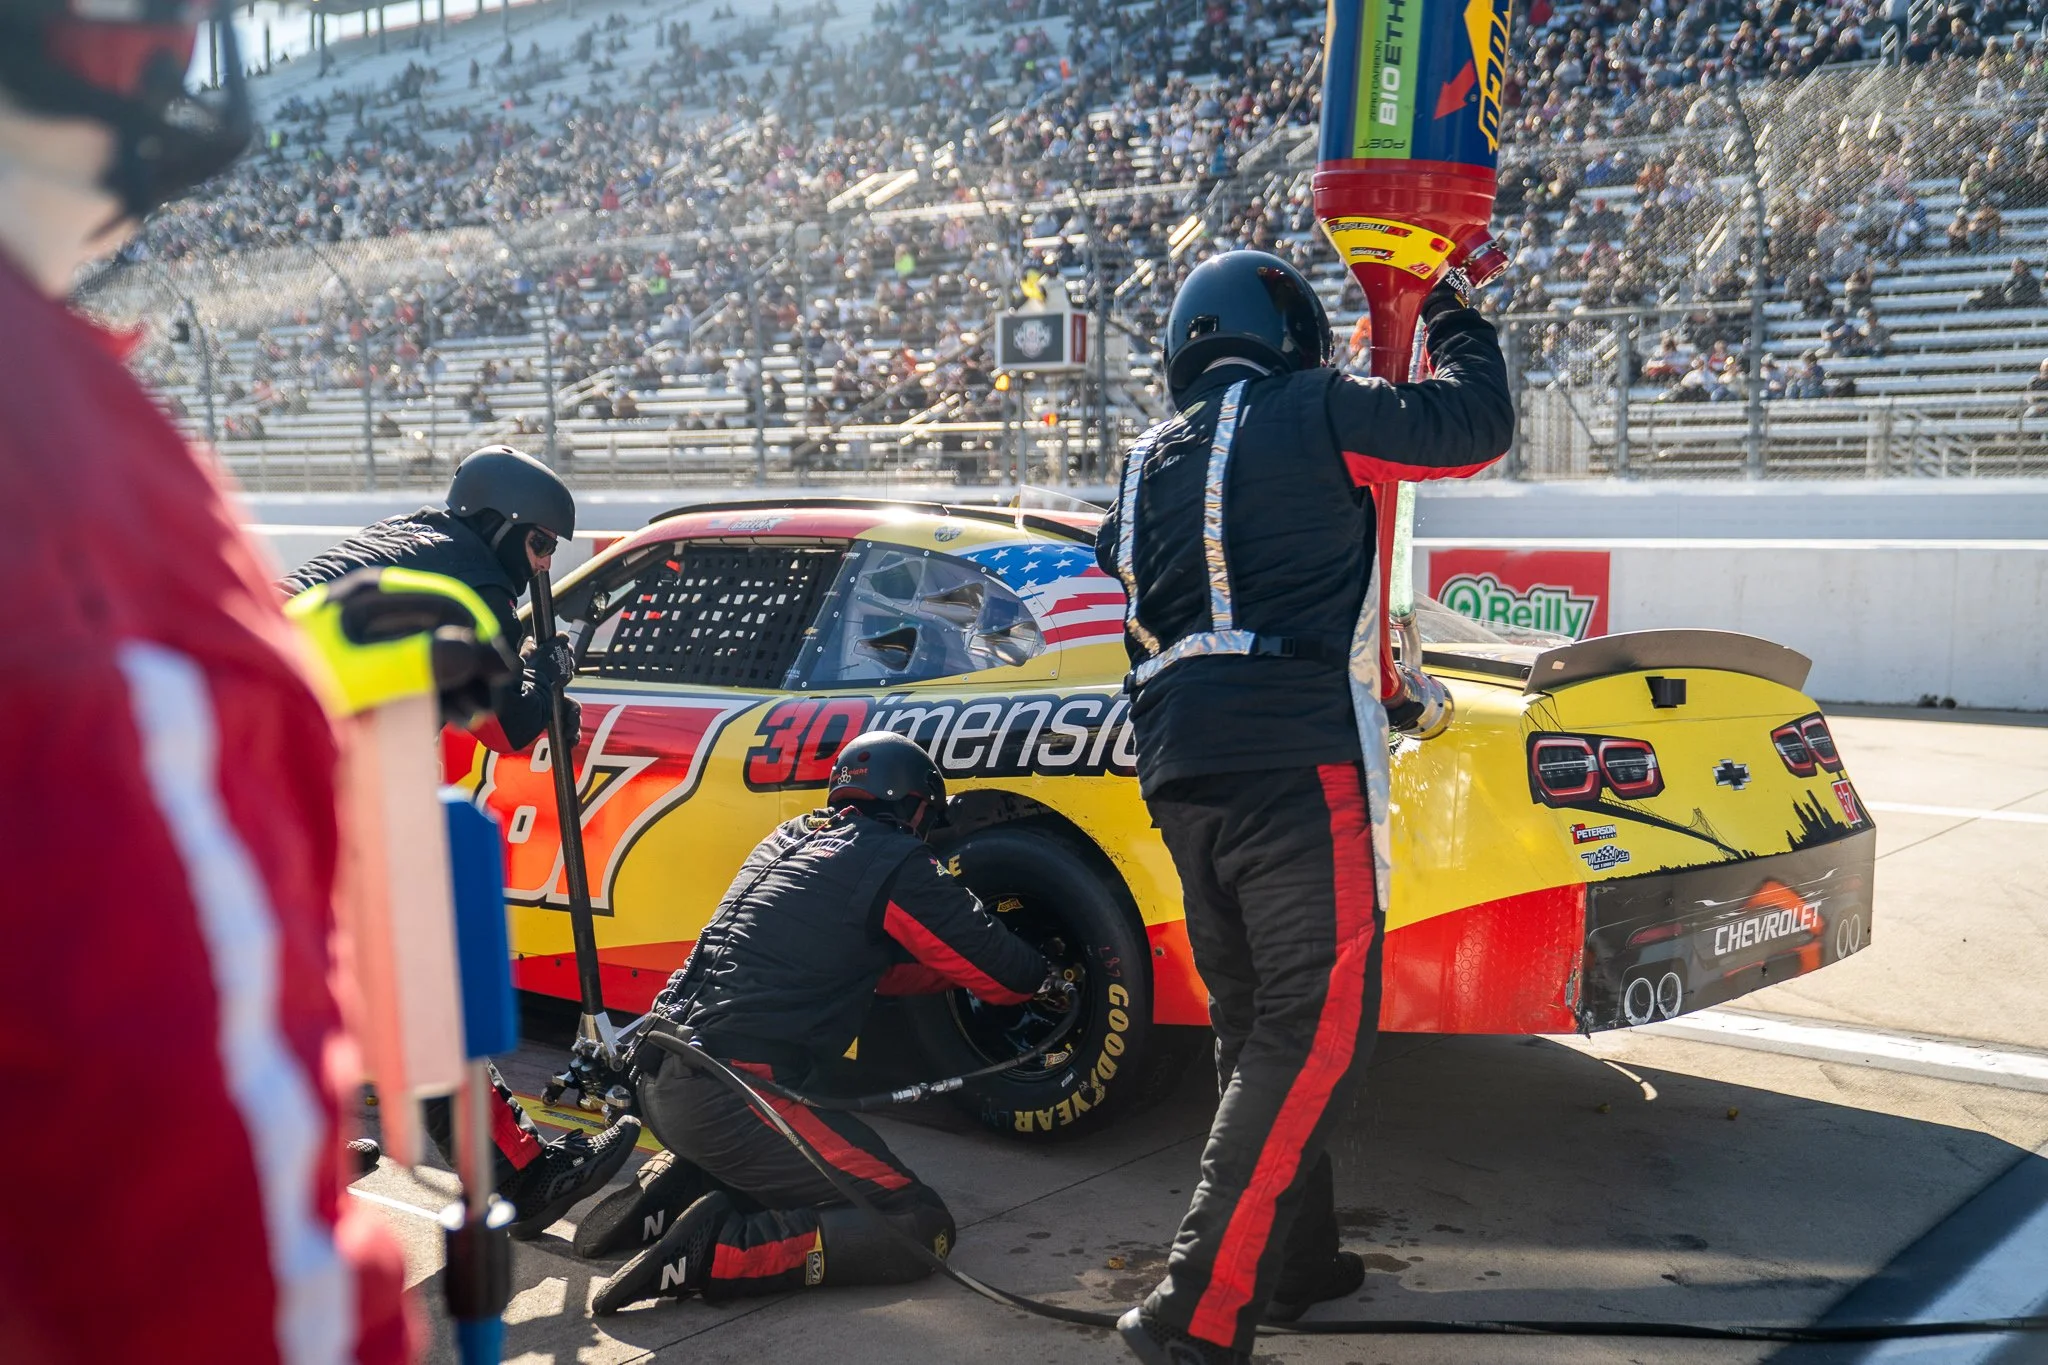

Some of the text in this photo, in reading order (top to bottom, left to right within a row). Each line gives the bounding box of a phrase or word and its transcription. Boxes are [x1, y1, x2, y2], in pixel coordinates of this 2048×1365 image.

[1447, 584, 1582, 639] O'Reilly
[1576, 825, 1617, 840] PETERSON
[1714, 900, 1822, 957] CHEVROLET
[1014, 982, 1130, 1133] GOODYEAR
[660, 1256, 687, 1291] N
